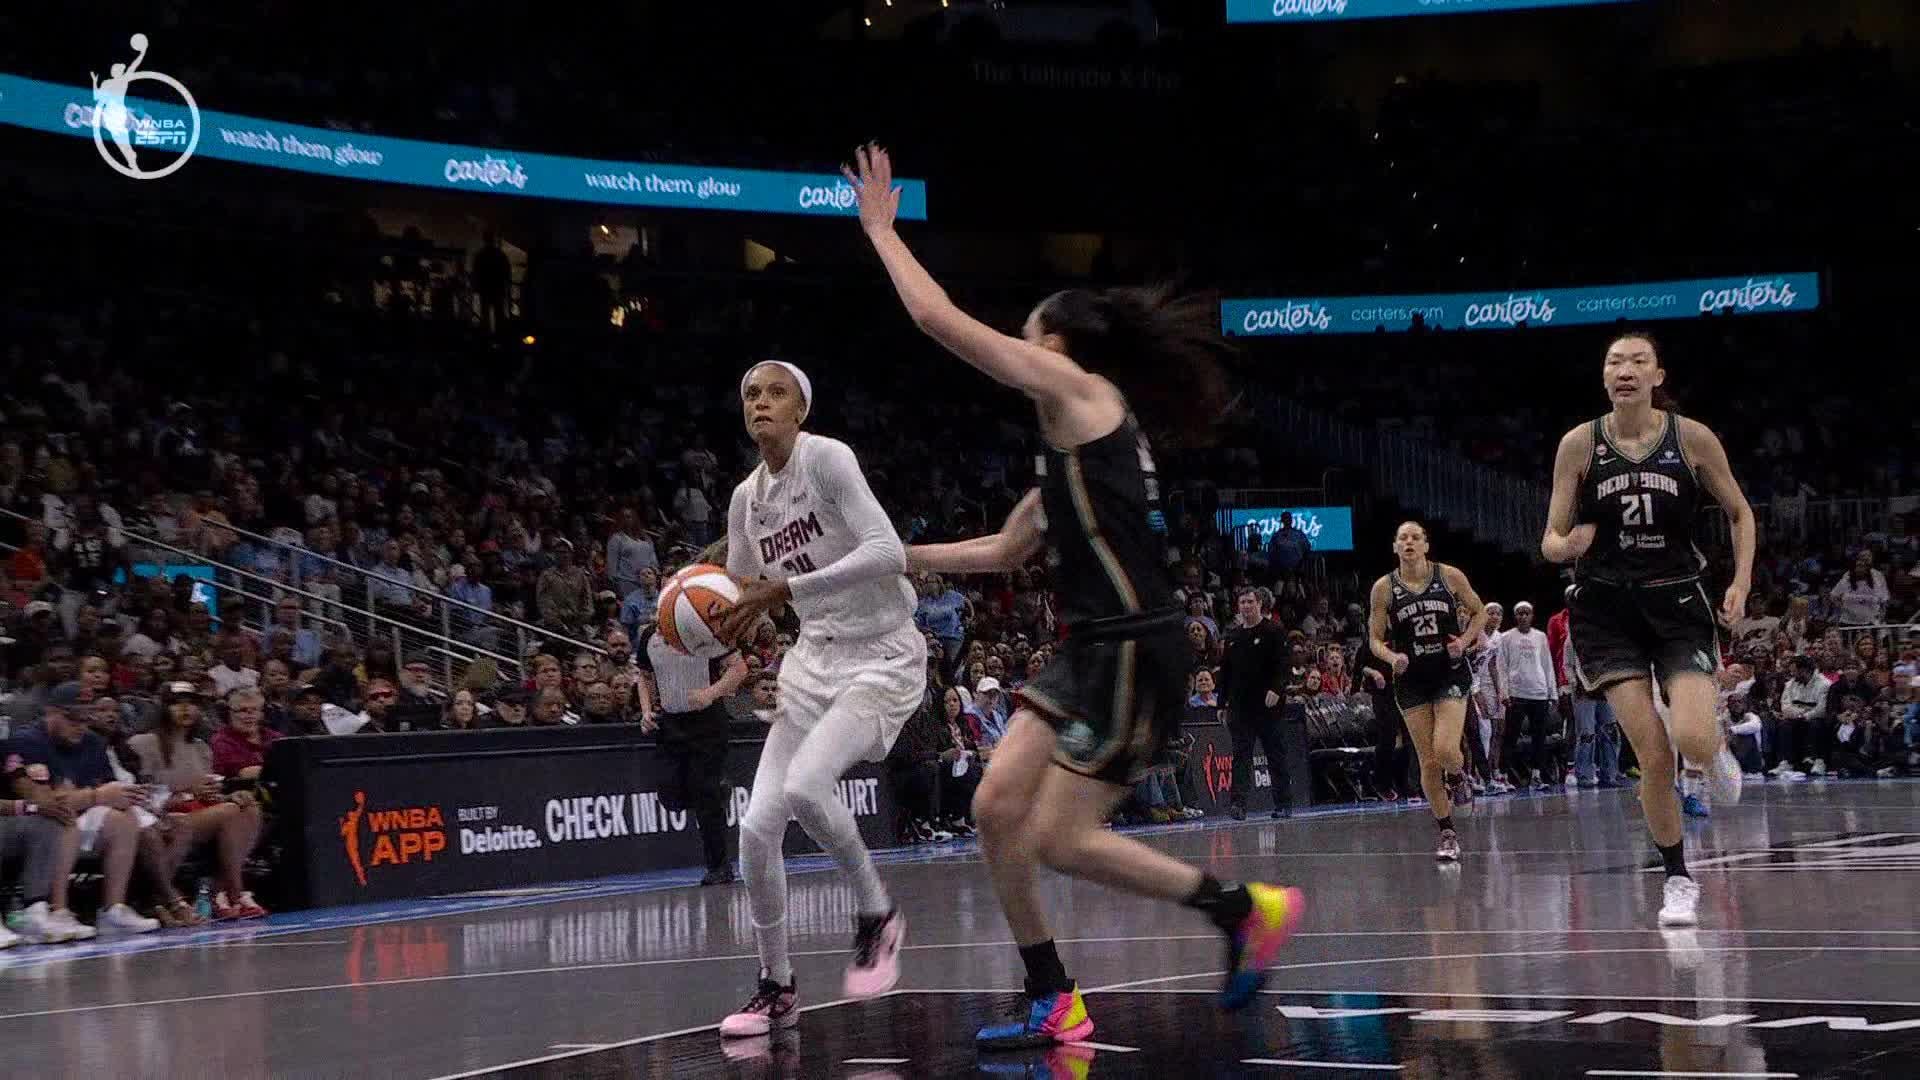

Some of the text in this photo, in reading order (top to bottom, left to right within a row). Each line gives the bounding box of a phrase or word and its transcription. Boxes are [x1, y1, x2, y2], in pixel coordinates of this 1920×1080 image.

[218, 127, 384, 168] watch them glow
[584, 171, 741, 200] watch them glow
[1576, 293, 1677, 313] carters.com
[1597, 473, 1630, 500] NEW
[1620, 493, 1654, 526] 21
[760, 511, 824, 565] DREAM
[1411, 612, 1439, 637] 23
[368, 805, 445, 833] WNBA
[545, 794, 629, 843] CHECK
[369, 831, 446, 867] APP
[460, 825, 542, 855] Deloitte.
